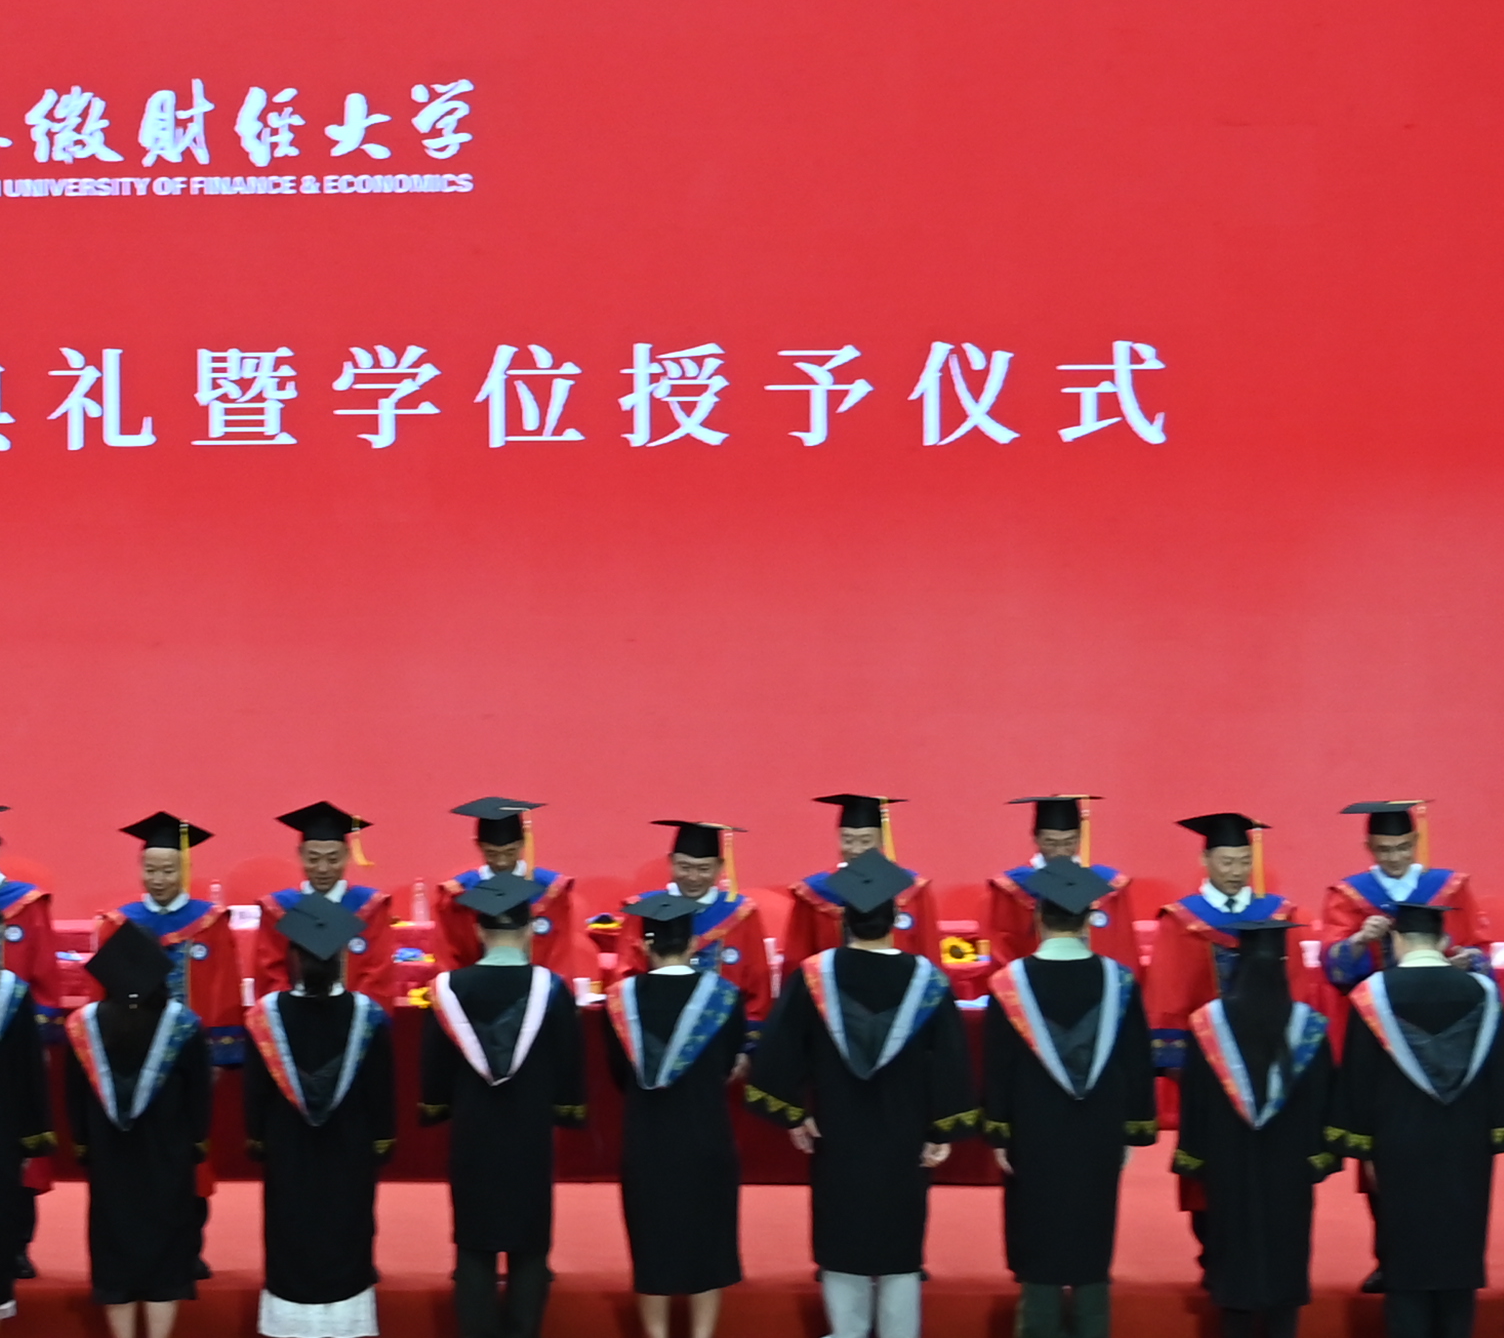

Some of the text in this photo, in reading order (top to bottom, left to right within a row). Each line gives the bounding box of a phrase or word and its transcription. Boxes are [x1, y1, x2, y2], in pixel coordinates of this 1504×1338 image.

[3, 177, 151, 198] UNIVERSITY
[152, 177, 188, 196] OF
[190, 175, 297, 195] FINANCE
[299, 175, 320, 194] &
[323, 173, 474, 194] ECONOMICS
